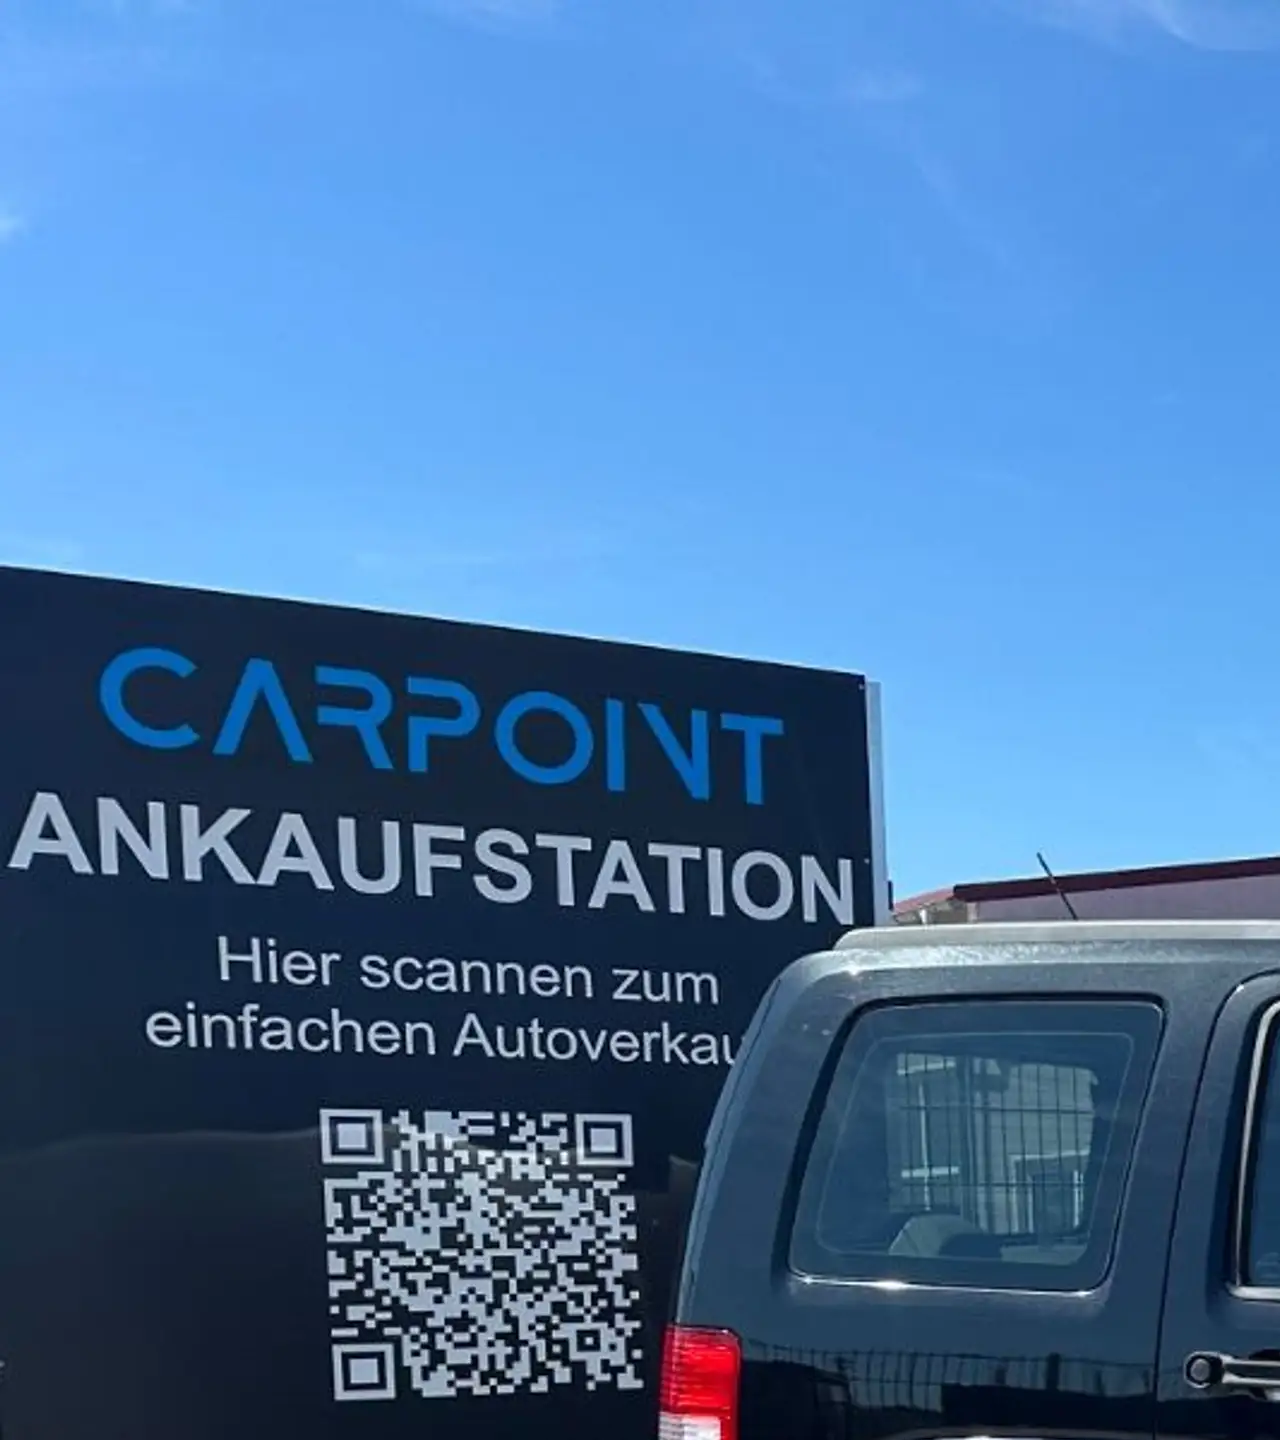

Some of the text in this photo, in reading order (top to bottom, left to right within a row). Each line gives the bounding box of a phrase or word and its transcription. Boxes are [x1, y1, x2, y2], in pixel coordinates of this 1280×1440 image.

[99, 646, 785, 805] CARPOINT
[8, 791, 854, 926] ANKAUFSTATION
[218, 935, 719, 1005] Hier scannen zum
[146, 1001, 436, 1056] einfachen
